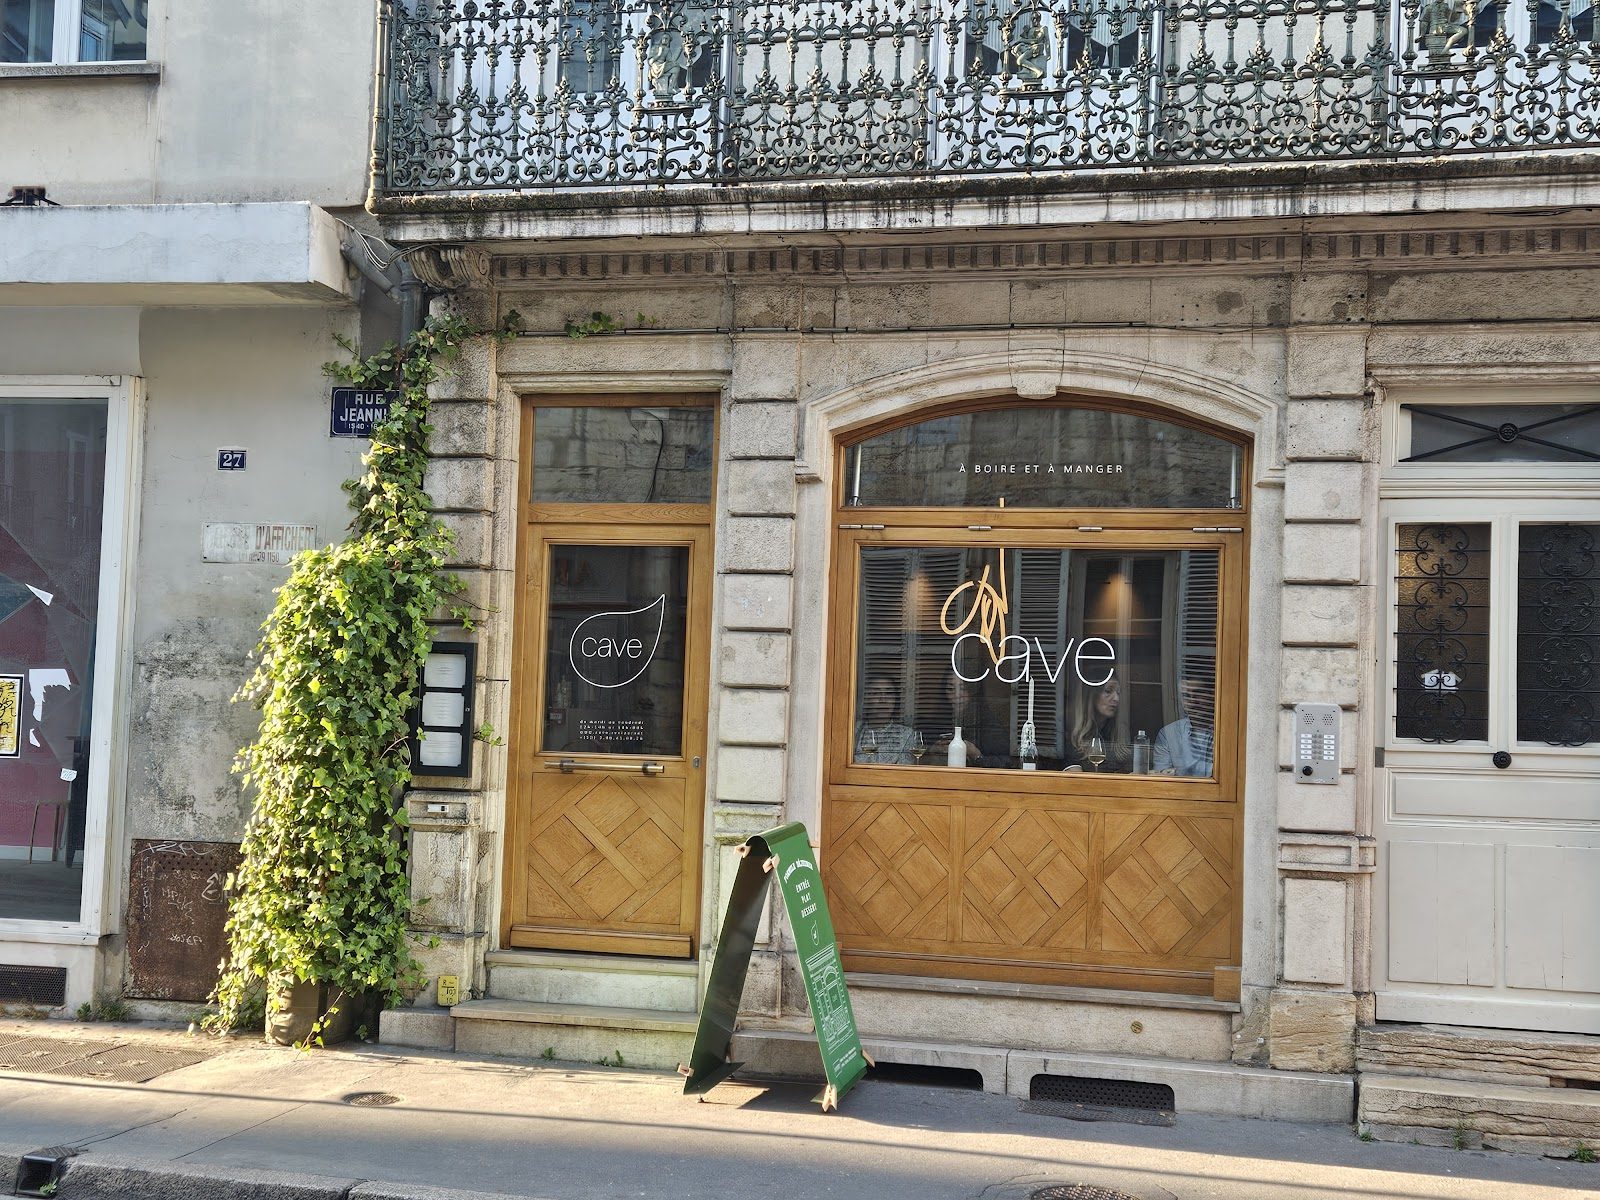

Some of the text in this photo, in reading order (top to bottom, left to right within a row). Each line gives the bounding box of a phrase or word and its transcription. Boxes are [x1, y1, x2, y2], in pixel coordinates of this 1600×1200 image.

[355, 393, 385, 405] RUE
[222, 453, 242, 467] 27
[958, 463, 1123, 474] À BOIRE ET À MANGER
[581, 637, 642, 659] cave
[951, 633, 1116, 686] cave
